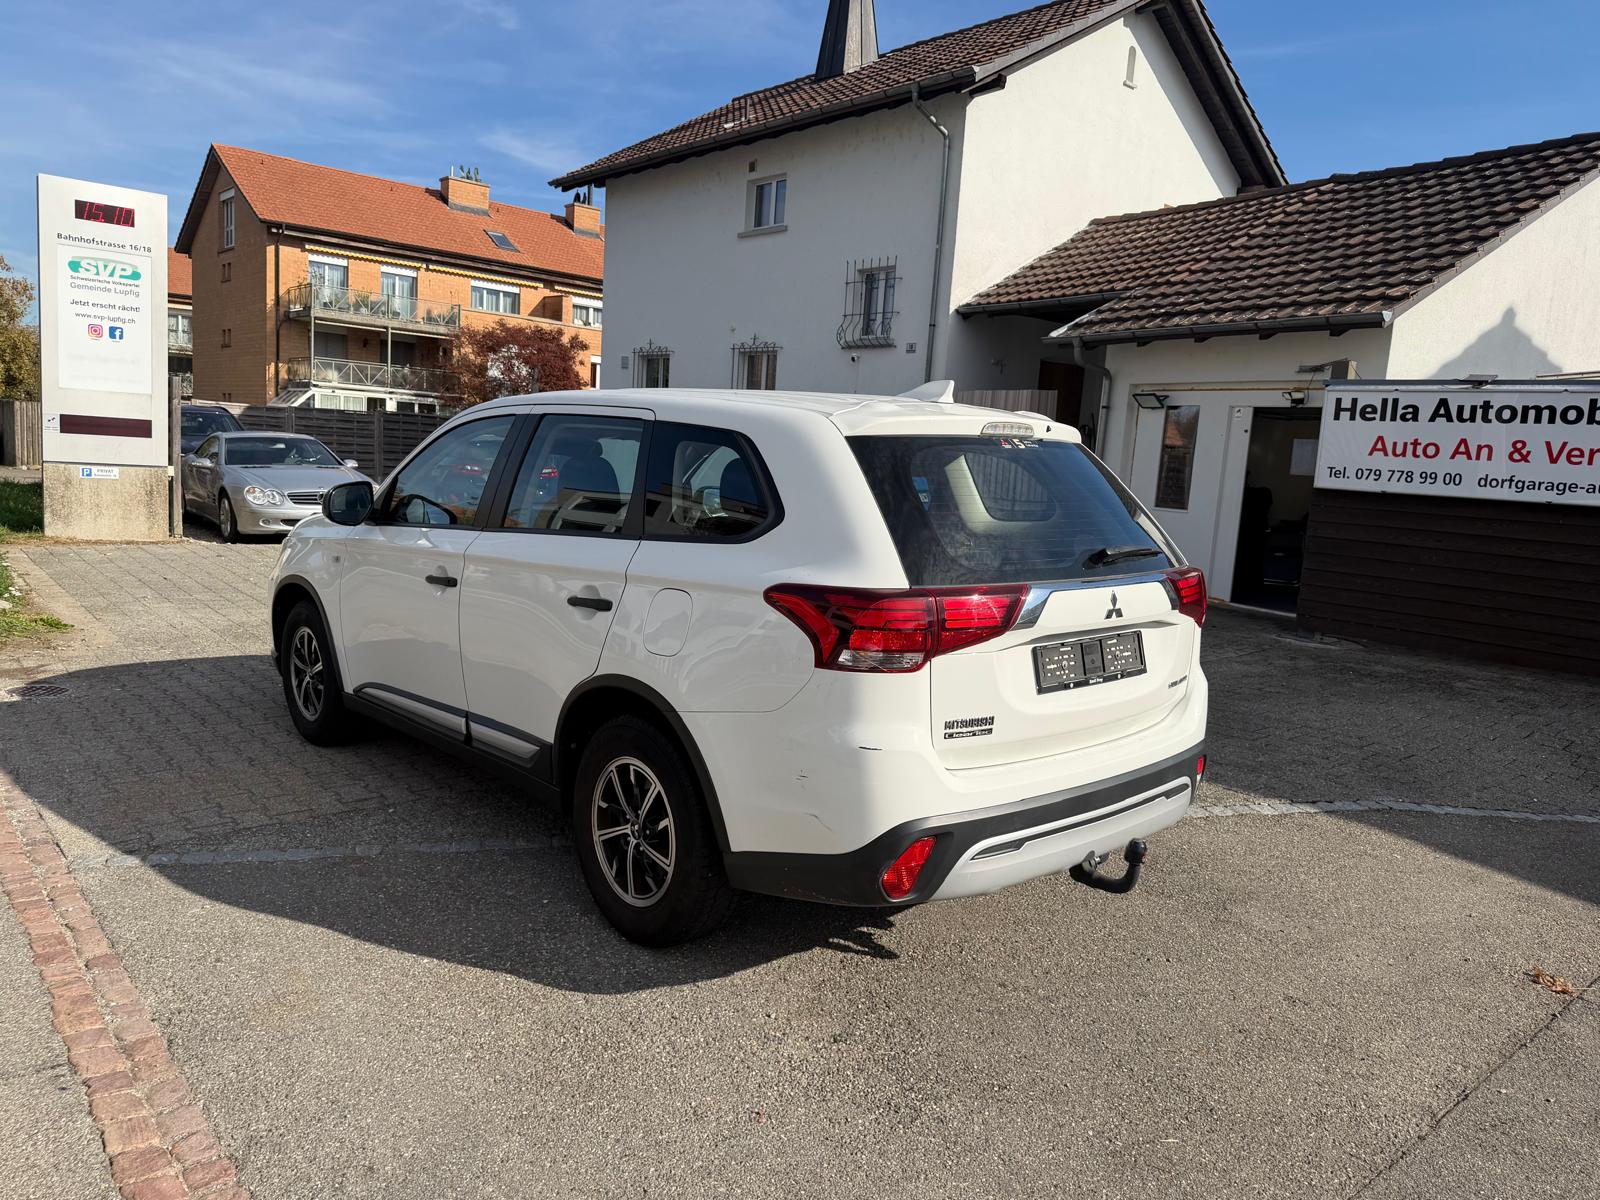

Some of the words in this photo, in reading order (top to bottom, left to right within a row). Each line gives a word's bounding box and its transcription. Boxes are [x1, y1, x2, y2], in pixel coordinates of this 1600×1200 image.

[57, 232, 126, 249] Bahnhofstrasse
[129, 244, 152, 253] 16/18
[77, 258, 133, 278] SVP
[70, 281, 112, 293] Gemeinde
[114, 287, 140, 297] Lupfig
[70, 298, 90, 307] Jetzt
[91, 302, 116, 310] erscht
[75, 312, 136, 324] www.svp-lupfig.ch
[1333, 397, 1419, 422] Hella
[1368, 435, 1440, 460] Auto
[1449, 438, 1494, 462] An
[1508, 439, 1531, 464] &
[1544, 440, 1600, 466] Ver
[1327, 466, 1350, 480] Tel.
[1355, 468, 1382, 482] 079
[1387, 469, 1415, 484] 778
[1419, 471, 1438, 485] 99
[1443, 472, 1463, 487] 00
[1477, 474, 1600, 496] dorfgarage-a
[944, 716, 995, 730] MITSUBISHI
